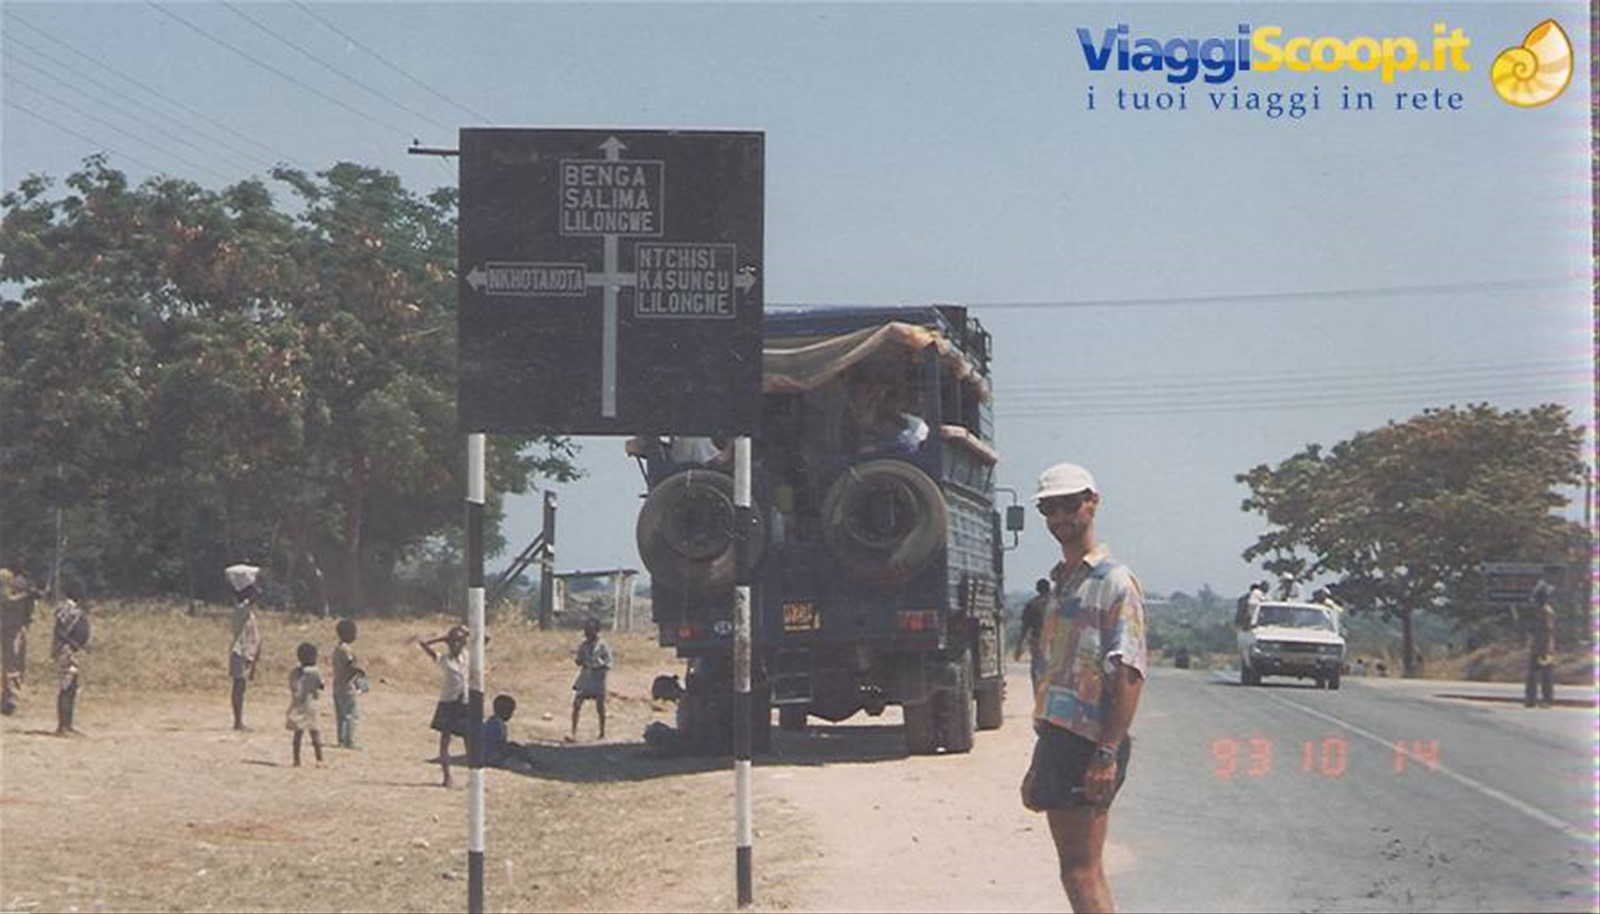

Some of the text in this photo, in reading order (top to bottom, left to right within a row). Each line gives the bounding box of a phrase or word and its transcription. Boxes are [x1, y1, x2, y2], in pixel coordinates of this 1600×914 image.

[565, 165, 646, 186] BENGA
[564, 189, 650, 210] SALIMA
[563, 211, 654, 233] LILONGWE
[639, 248, 715, 269] NTCHISI
[488, 269, 584, 290] NKHOTAKOTA
[638, 270, 730, 292] KASUNGU
[639, 293, 729, 314] LILONGWE
